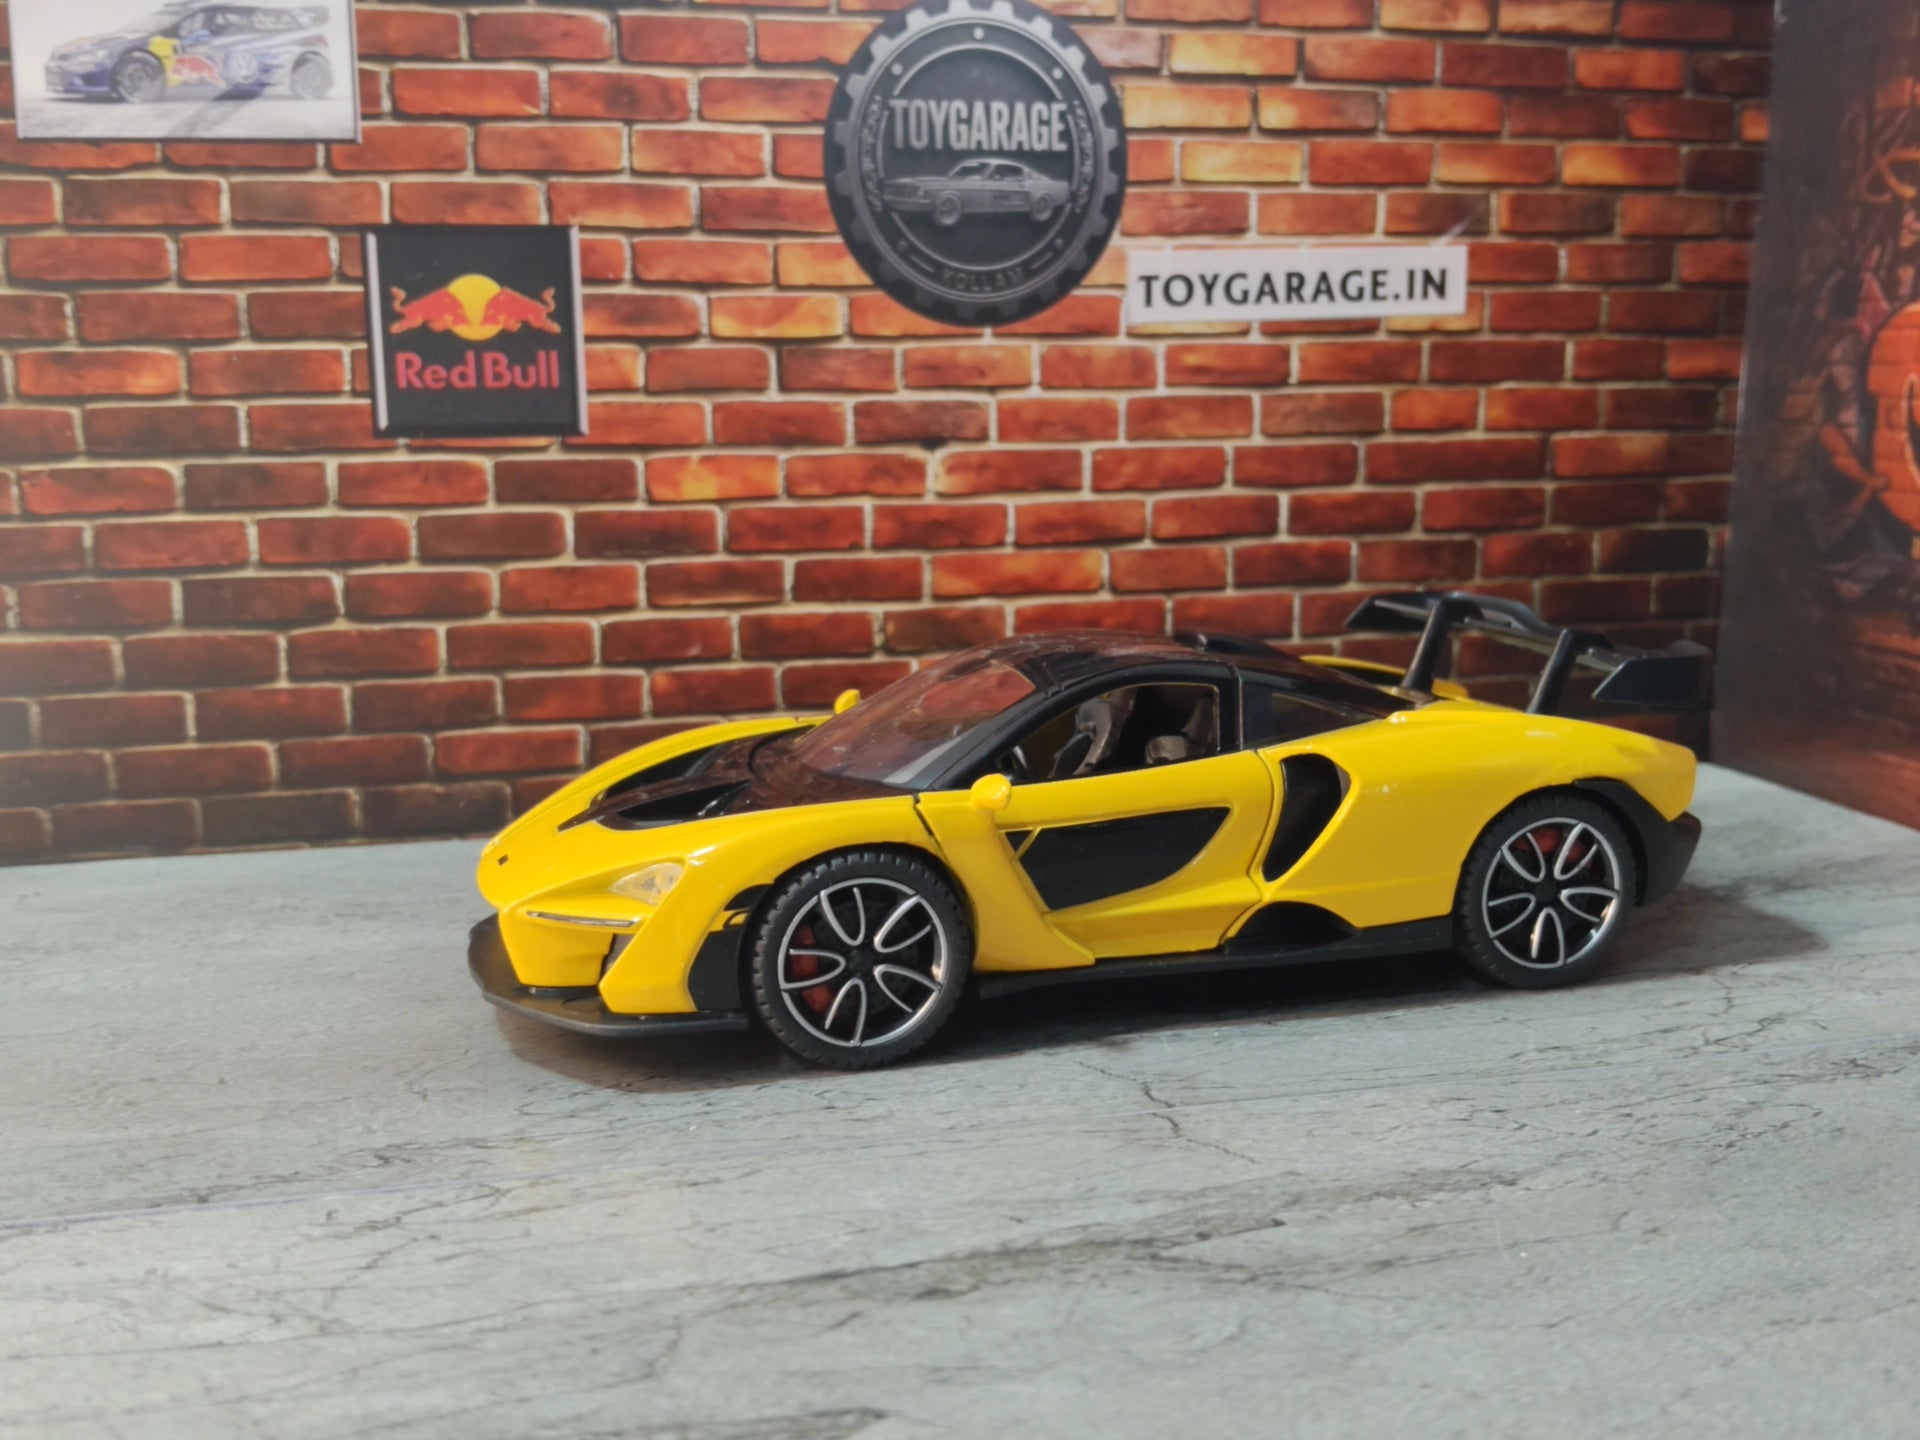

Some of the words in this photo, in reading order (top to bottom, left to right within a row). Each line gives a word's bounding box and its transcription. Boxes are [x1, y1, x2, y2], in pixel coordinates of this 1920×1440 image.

[889, 99, 1068, 152] TOYGARAGE
[1139, 269, 1448, 308] TOYGARAGE.IN
[395, 350, 477, 389] Red
[483, 350, 560, 390] Bull
